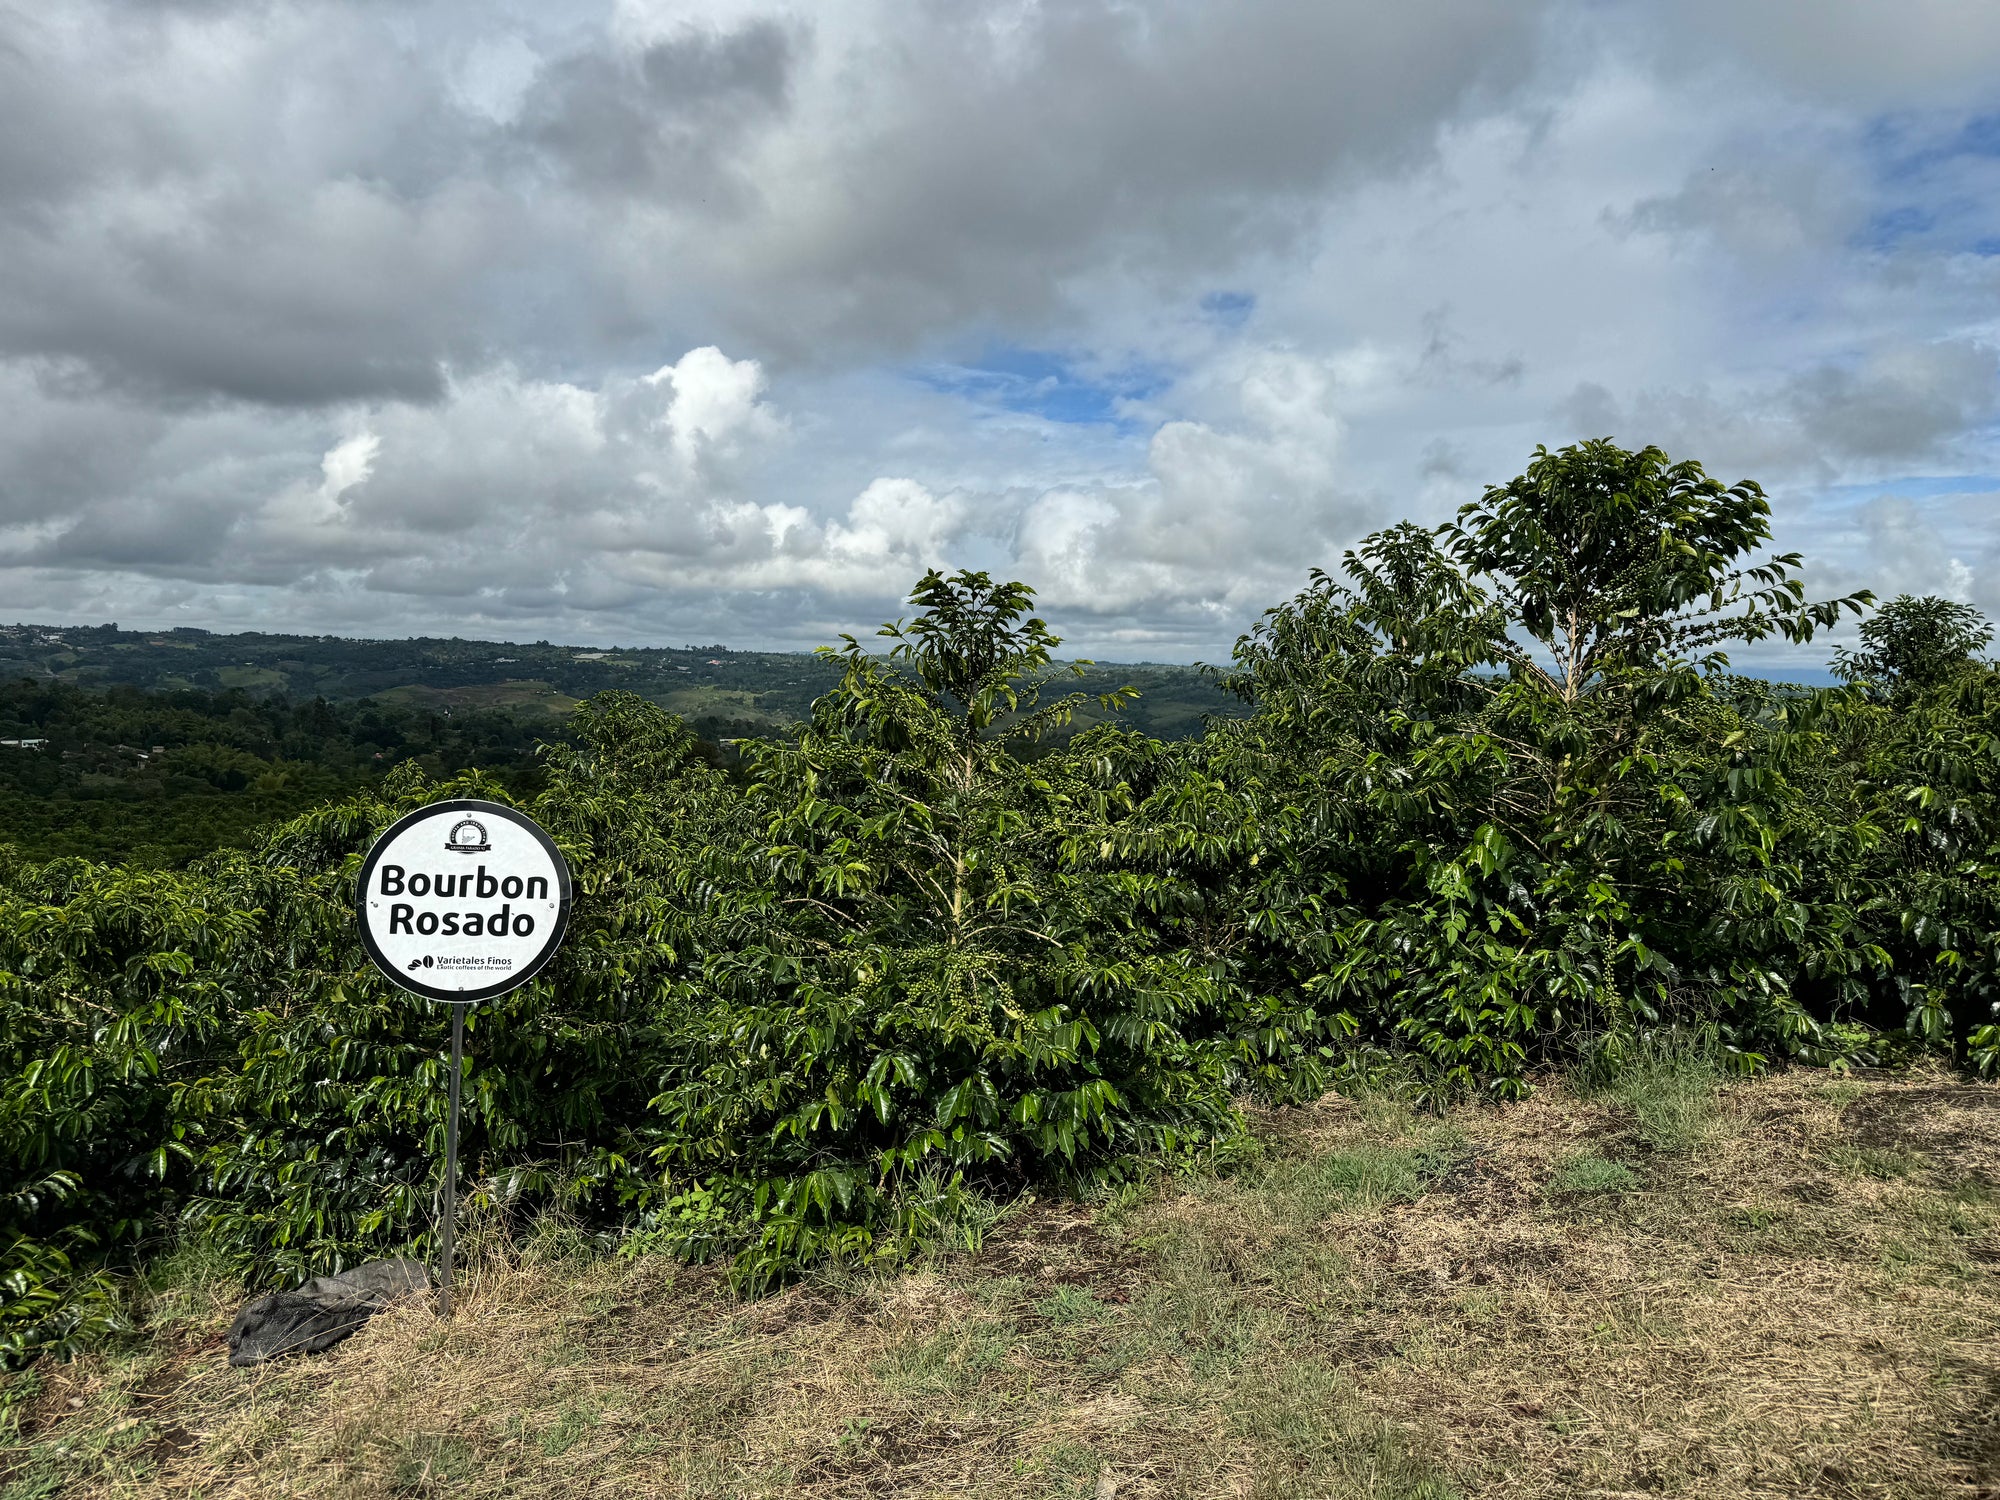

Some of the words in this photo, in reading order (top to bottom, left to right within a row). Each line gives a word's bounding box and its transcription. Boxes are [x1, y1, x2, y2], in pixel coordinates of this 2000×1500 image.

[381, 864, 549, 899] Bourbon
[389, 903, 535, 937] Rosado
[437, 956, 485, 965] Varietales
[487, 956, 512, 965] Finos
